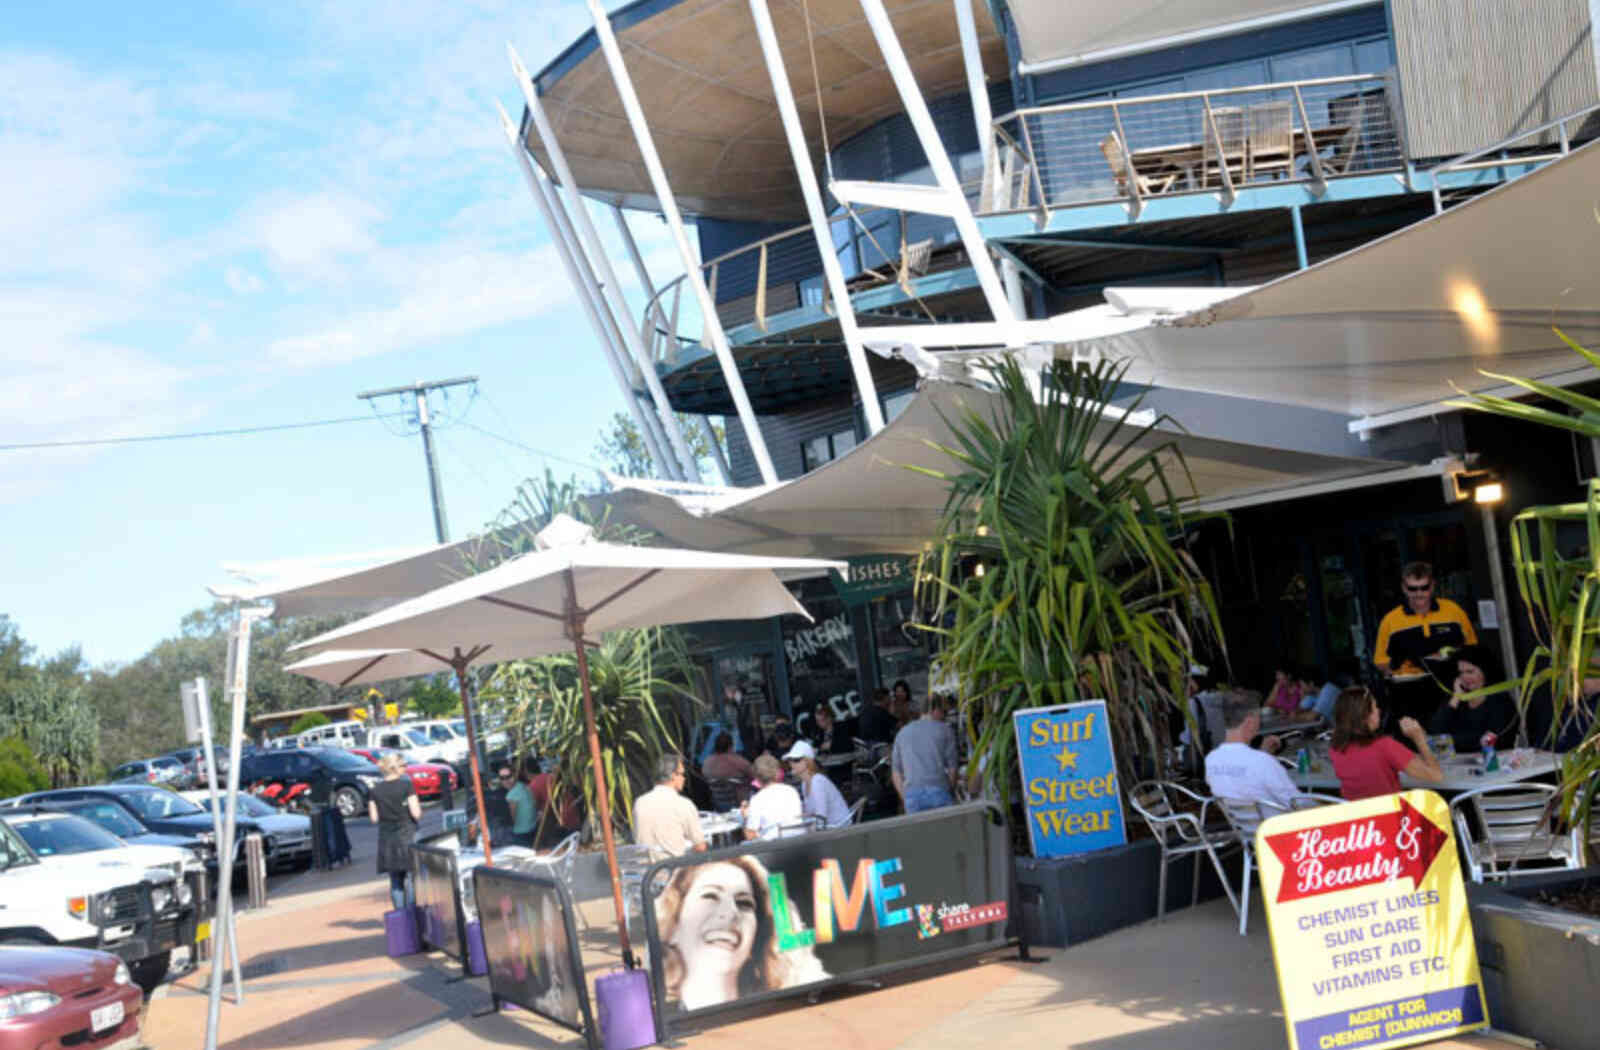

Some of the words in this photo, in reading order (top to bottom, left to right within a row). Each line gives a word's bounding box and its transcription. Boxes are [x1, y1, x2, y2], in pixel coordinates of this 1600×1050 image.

[852, 562, 900, 582] ISHES
[784, 613, 852, 662] BAKERY
[1030, 713, 1096, 747] Surf
[1028, 771, 1117, 806] Street
[1035, 809, 1115, 838] Wear
[1291, 821, 1385, 862] Health
[1396, 816, 1423, 860] &
[1297, 853, 1403, 892] Beauty
[768, 857, 912, 951] LIVE
[1298, 901, 1379, 930] CHEMIST
[1386, 890, 1440, 912] LINES
[1324, 927, 1364, 949] SUN
[1370, 916, 1421, 939] CARE
[1332, 946, 1383, 969] FIRST
[1390, 938, 1421, 957] AID
[1313, 964, 1403, 996] VITAMINS
[1349, 1002, 1396, 1026] AGENT
[1398, 998, 1426, 1017] FOR
[1319, 1021, 1383, 1050] CHEMIST
